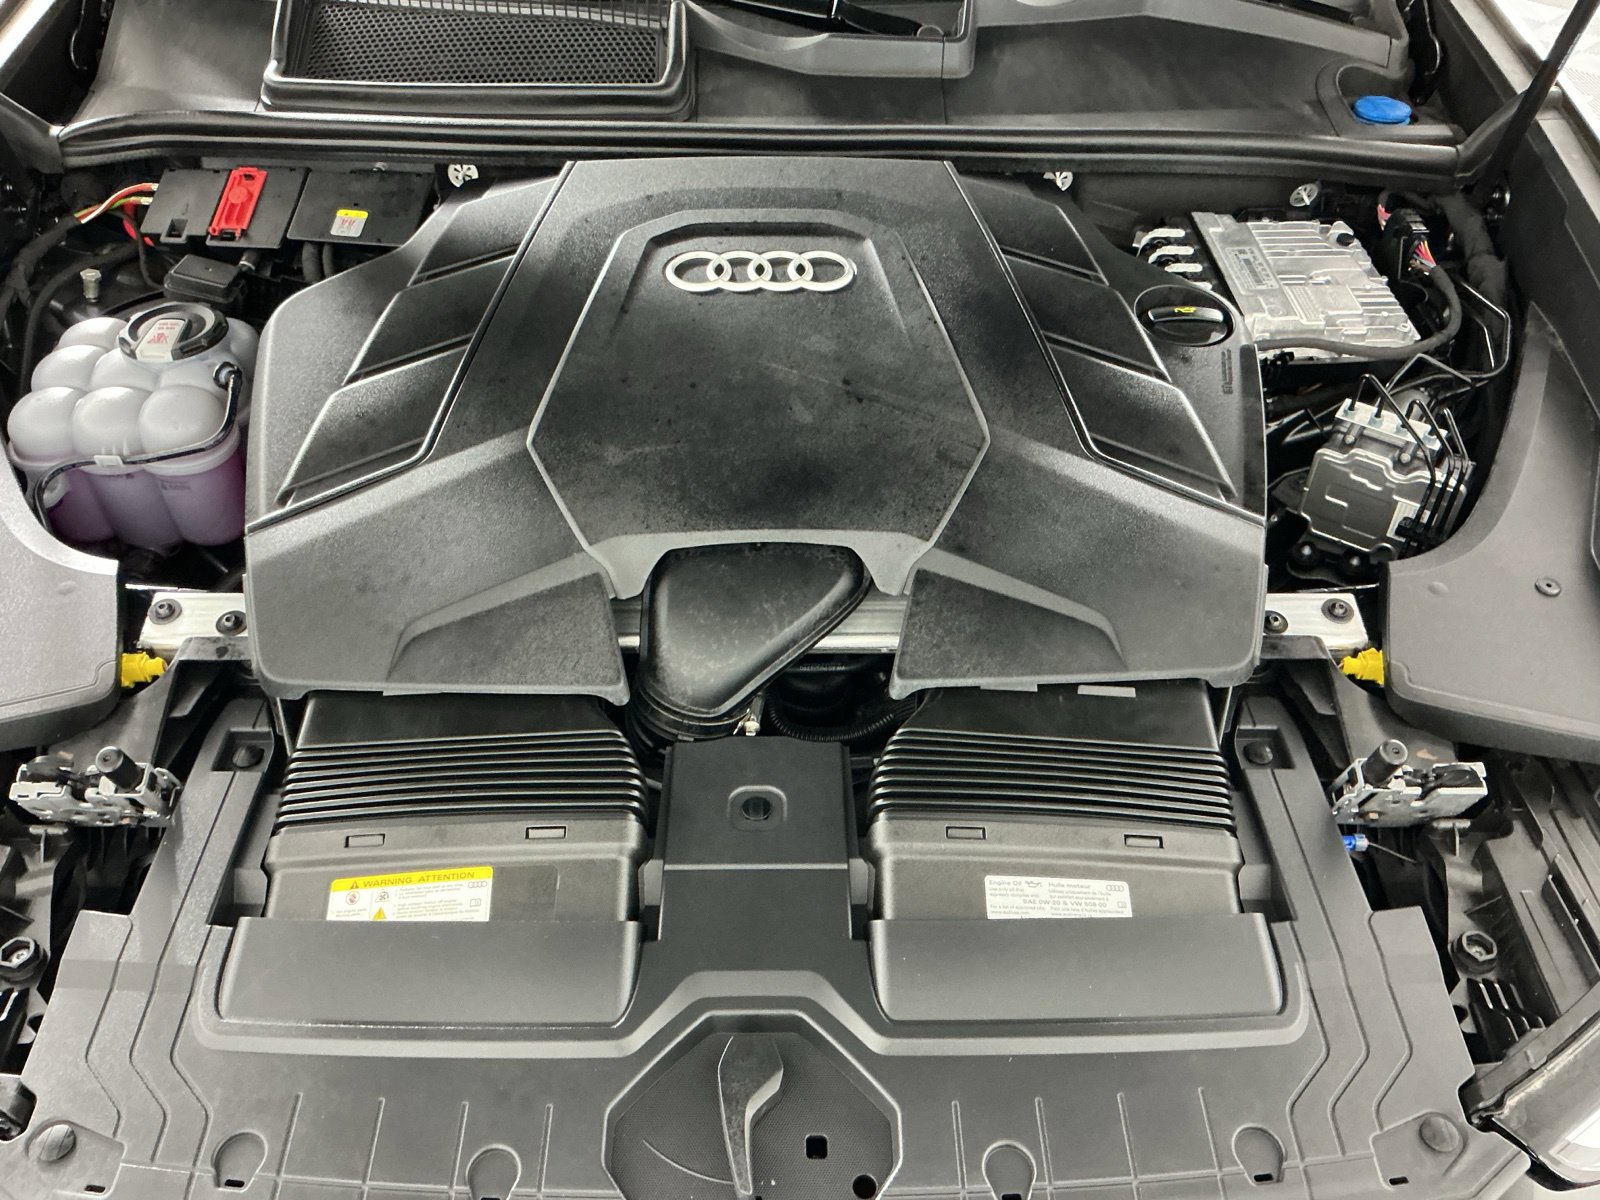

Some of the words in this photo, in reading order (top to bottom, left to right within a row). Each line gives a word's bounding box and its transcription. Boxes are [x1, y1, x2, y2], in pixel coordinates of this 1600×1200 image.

[363, 877, 412, 888] WARNING
[418, 871, 475, 883] ATTENTION
[989, 879, 1011, 887] Engine
